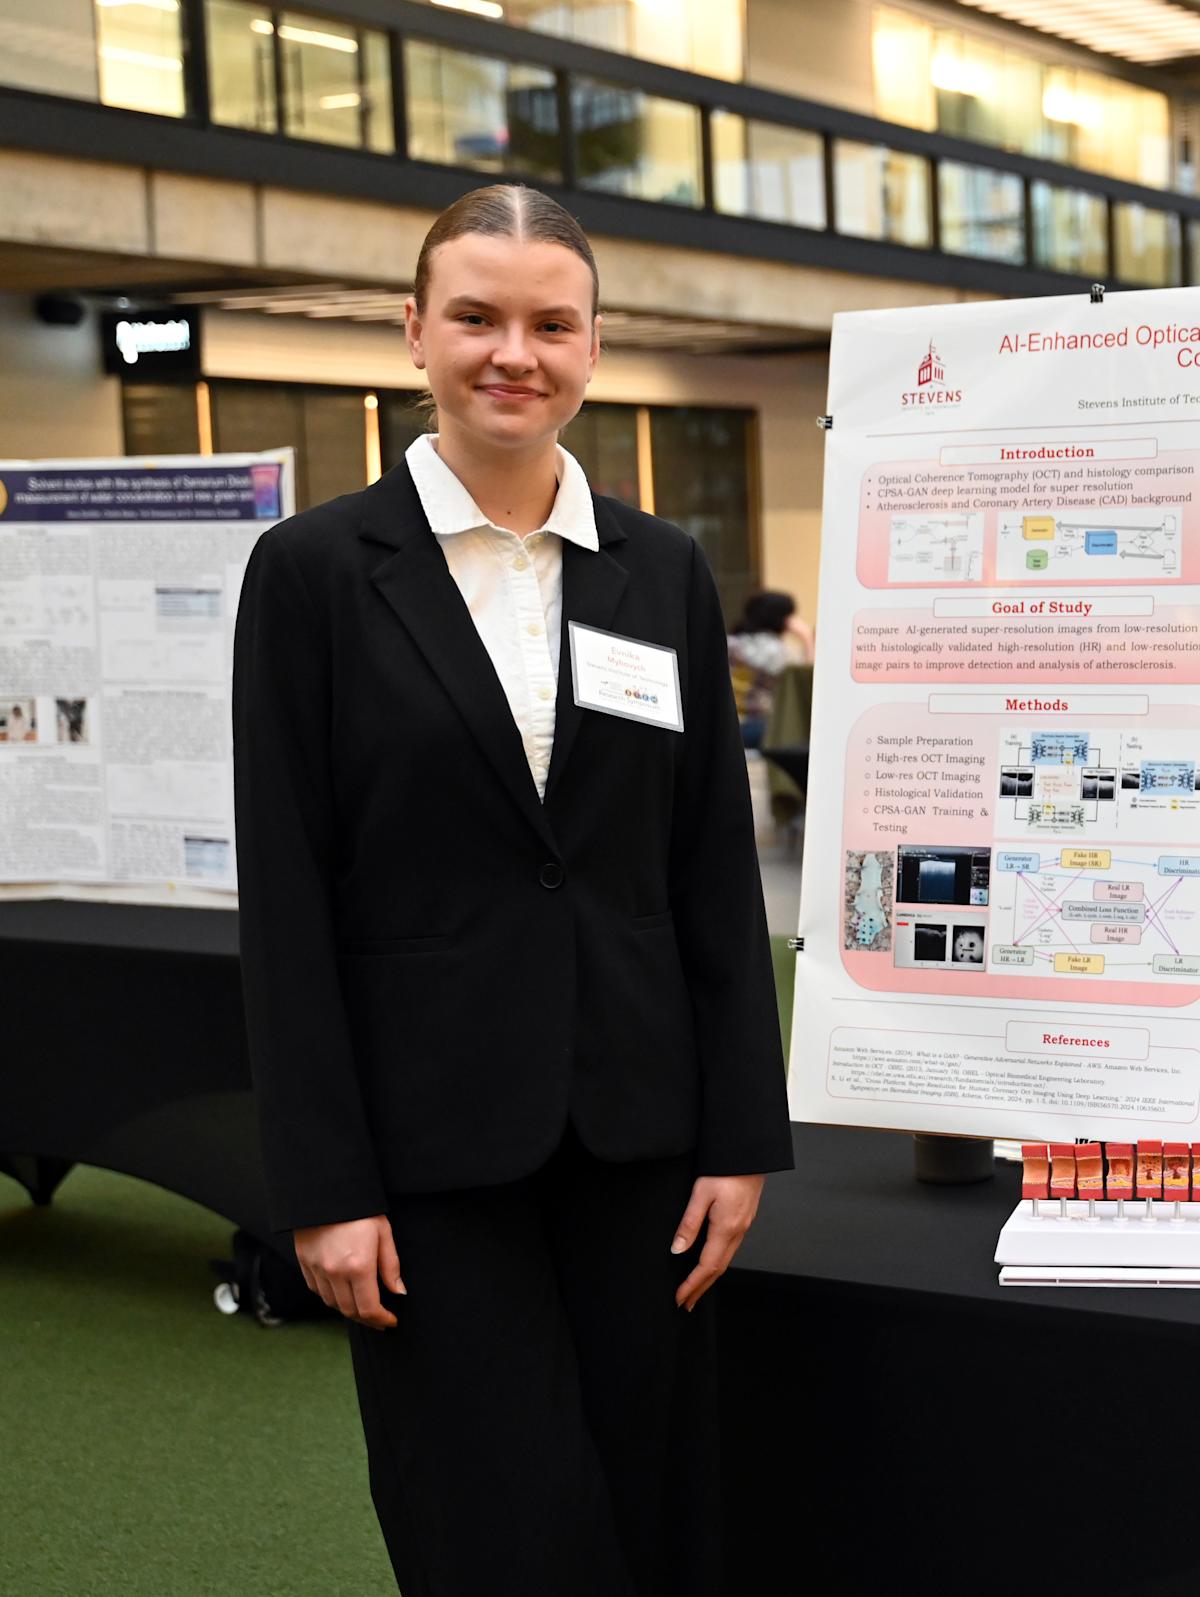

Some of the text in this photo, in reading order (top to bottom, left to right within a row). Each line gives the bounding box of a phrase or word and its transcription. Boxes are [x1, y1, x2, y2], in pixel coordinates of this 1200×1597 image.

[999, 327, 1127, 354] AI-Enhanced
[901, 389, 962, 405] STEVENS
[1077, 397, 1118, 409] Stevens
[1121, 395, 1166, 407] Institute
[1169, 393, 1181, 405] of
[1000, 445, 1094, 460] Introduction
[877, 463, 1194, 487] Optical Coherence Tomography (OCT) and histology comparison
[991, 600, 1092, 617] Goal of Study
[1005, 698, 1068, 711] Methods
[876, 735, 973, 748] Sample Preparation
[876, 752, 985, 767] High-res OCT Imaging
[875, 769, 981, 784] Low-res OCT Imaging
[874, 787, 983, 800] Histological Validation
[873, 804, 991, 819] CPSA-GAN Training &
[872, 821, 908, 834] Testing
[1068, 904, 1098, 913] Combined
[1113, 906, 1139, 914] Function
[1042, 1033, 1110, 1047] References
